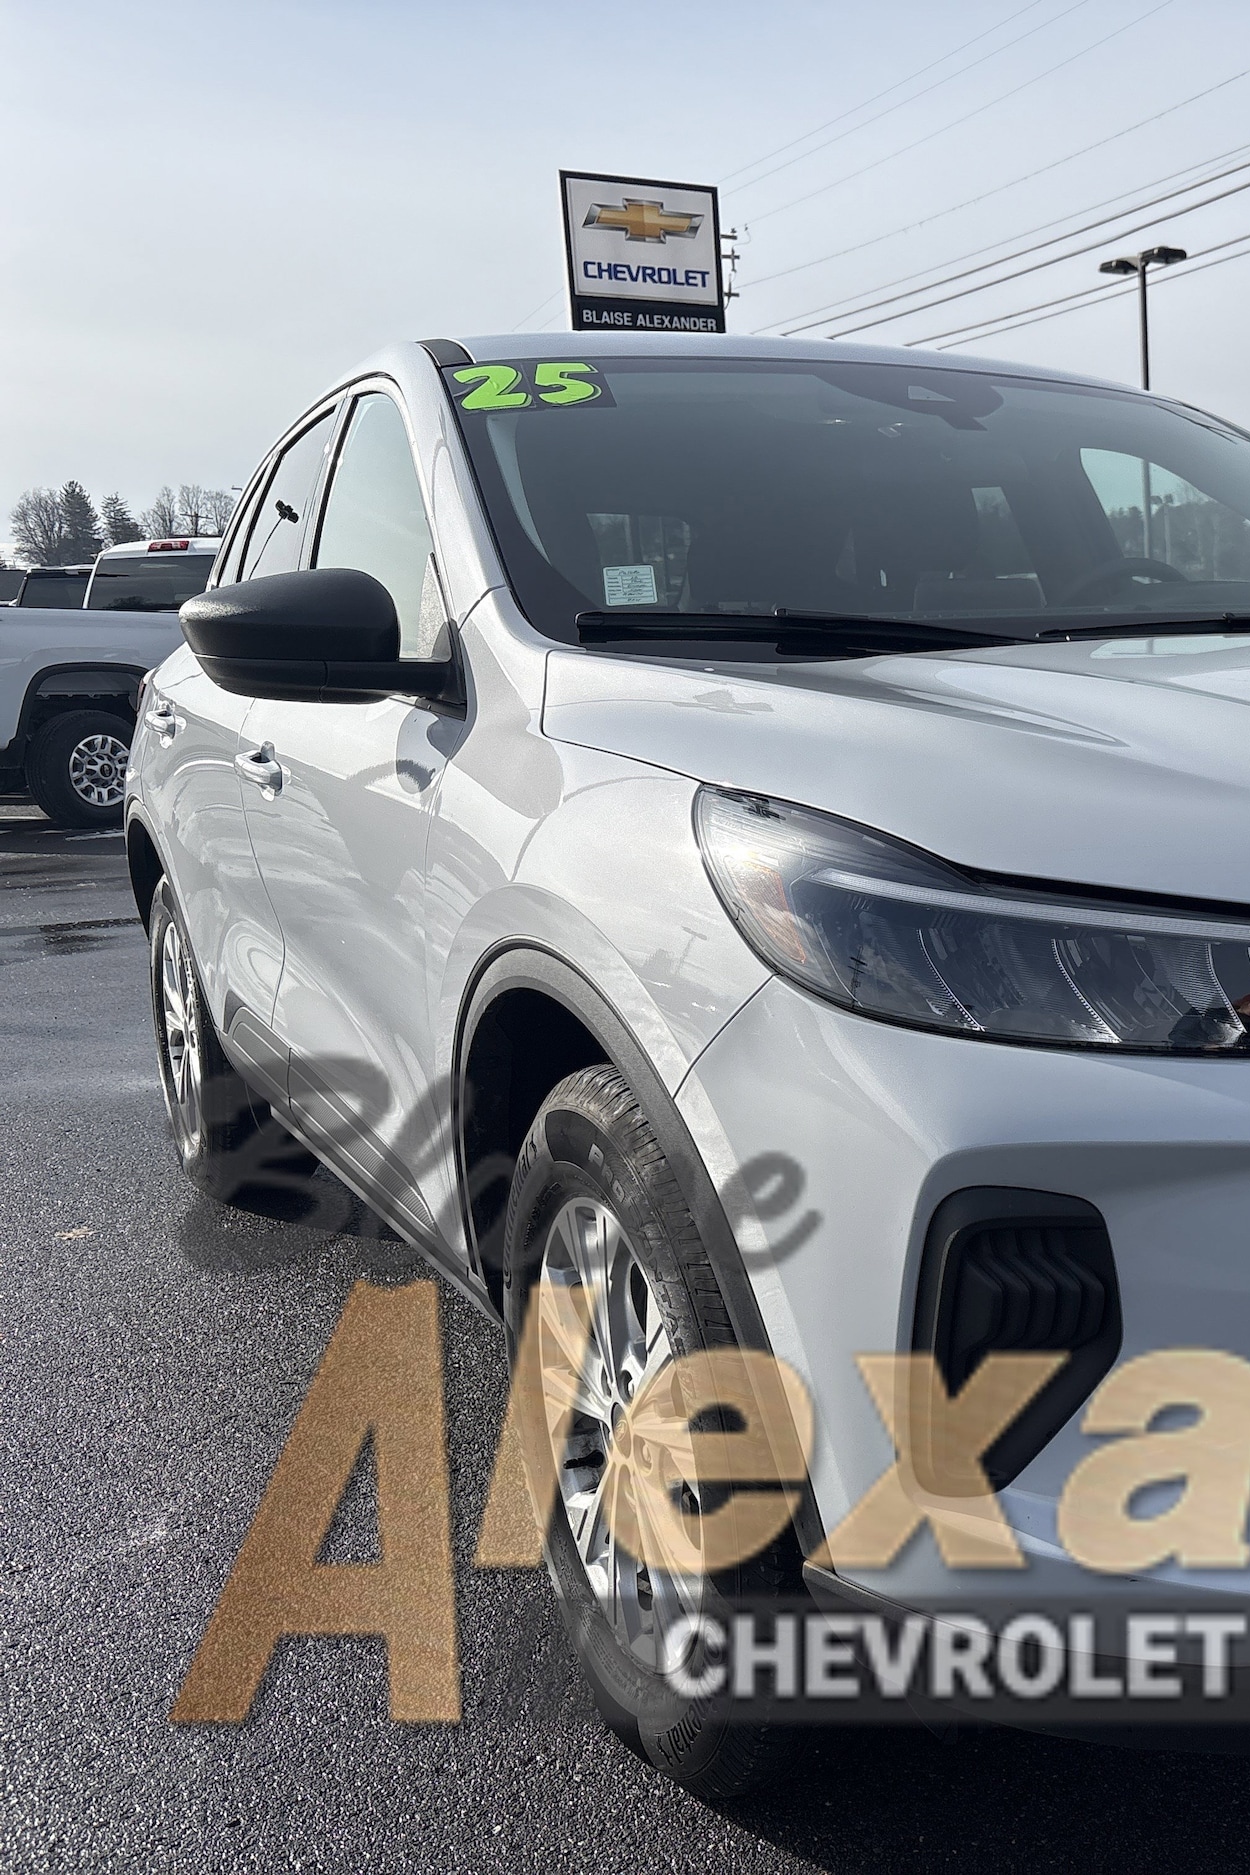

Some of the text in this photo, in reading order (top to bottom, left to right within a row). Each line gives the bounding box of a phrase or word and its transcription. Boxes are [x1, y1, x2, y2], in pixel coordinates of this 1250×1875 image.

[583, 261, 710, 288] CHEVROLET
[582, 309, 717, 331] BLAISE ALEXANDER
[453, 363, 602, 411] 25
